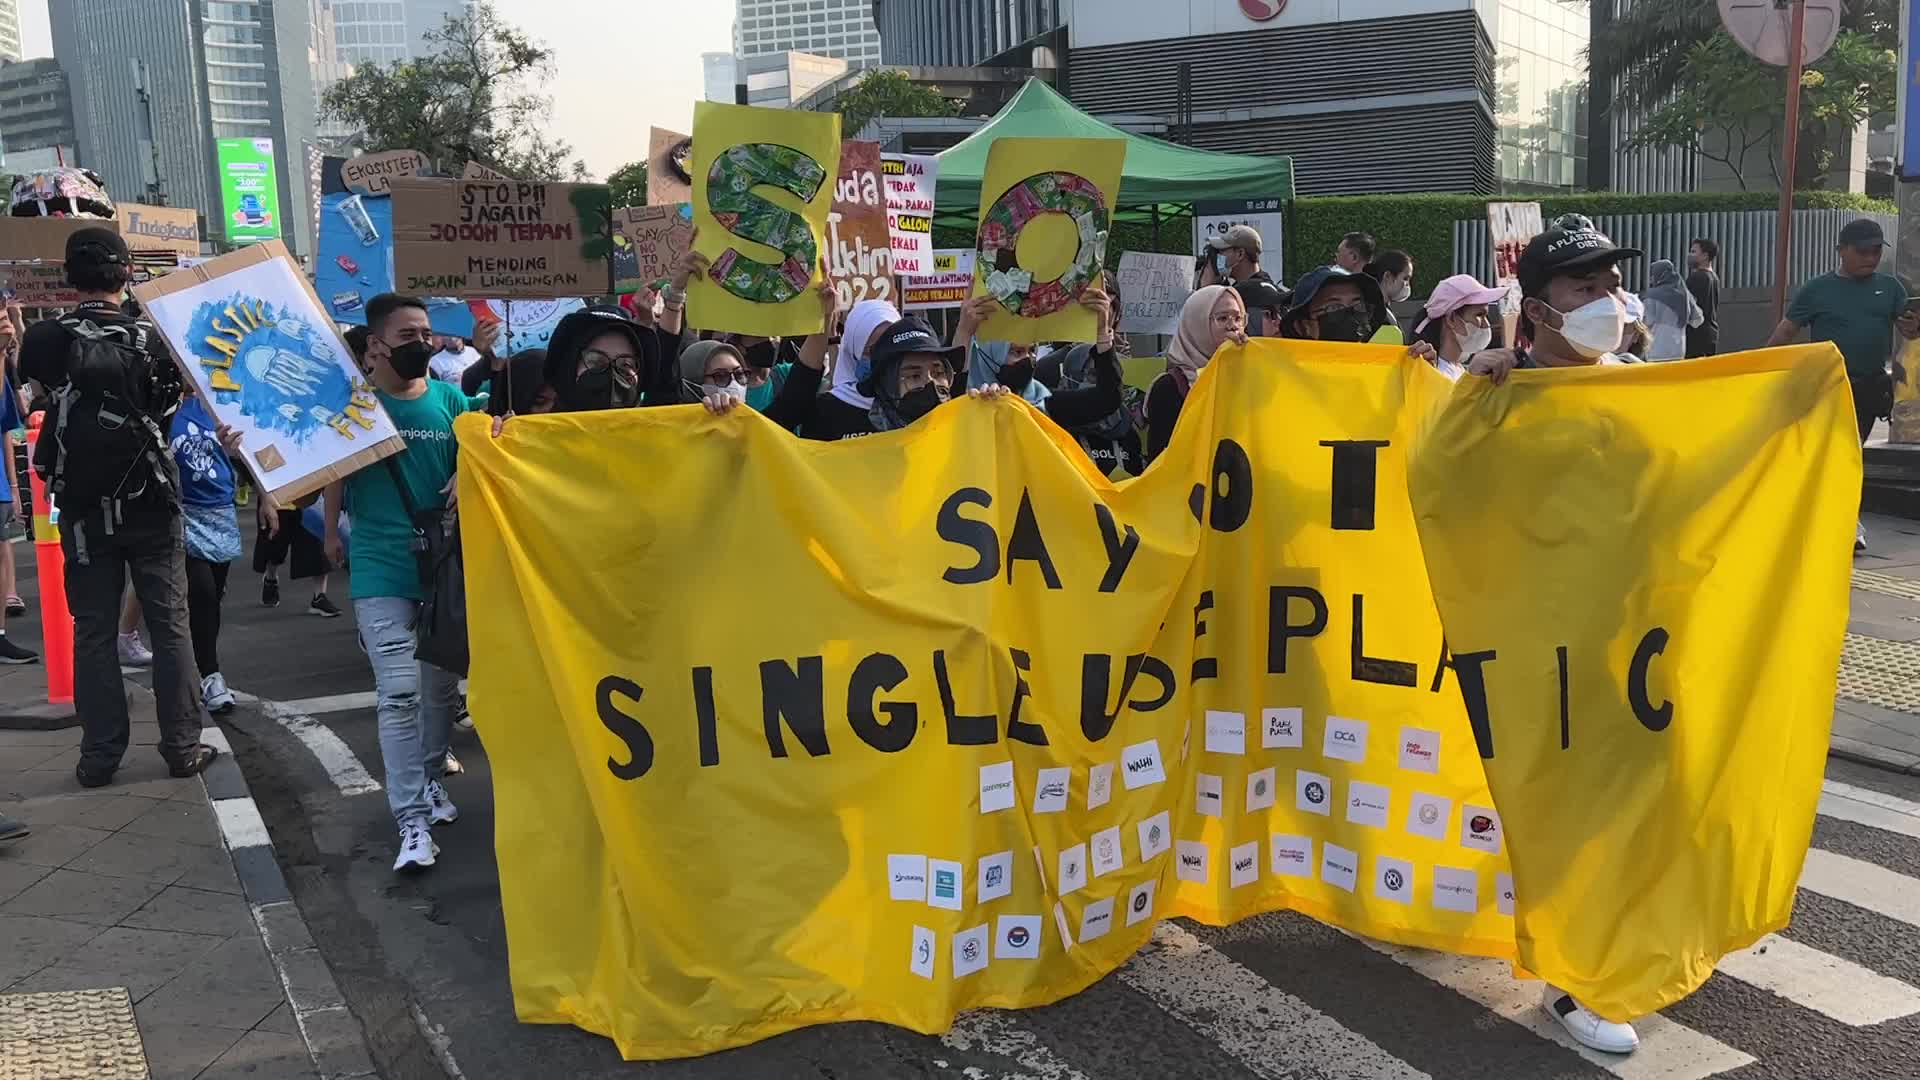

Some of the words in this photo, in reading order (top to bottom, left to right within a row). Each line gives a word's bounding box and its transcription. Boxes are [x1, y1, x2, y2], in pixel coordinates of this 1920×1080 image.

[347, 155, 423, 182] EKOSISTEM
[834, 170, 879, 205] uda
[460, 205, 542, 222] JAGAIN
[905, 200, 932, 211] PAKAI
[504, 223, 573, 242] TEMAN
[899, 216, 930, 232] GALON
[636, 227, 658, 243] SAY
[891, 236, 919, 250] EKALI
[827, 212, 893, 277] Iklim
[468, 256, 547, 274] MENDING
[894, 258, 919, 271] AKAI
[408, 275, 467, 289] JAGAIN
[480, 272, 577, 288] LINGKUNGAN
[837, 276, 891, 311] 022
[200, 299, 279, 392] PLASTIC
[327, 375, 377, 441] FREE
[399, 427, 434, 440] enjaga
[936, 486, 1139, 593] SAY
[596, 648, 1049, 780] SINGLE
[1334, 730, 1356, 742] DCA
